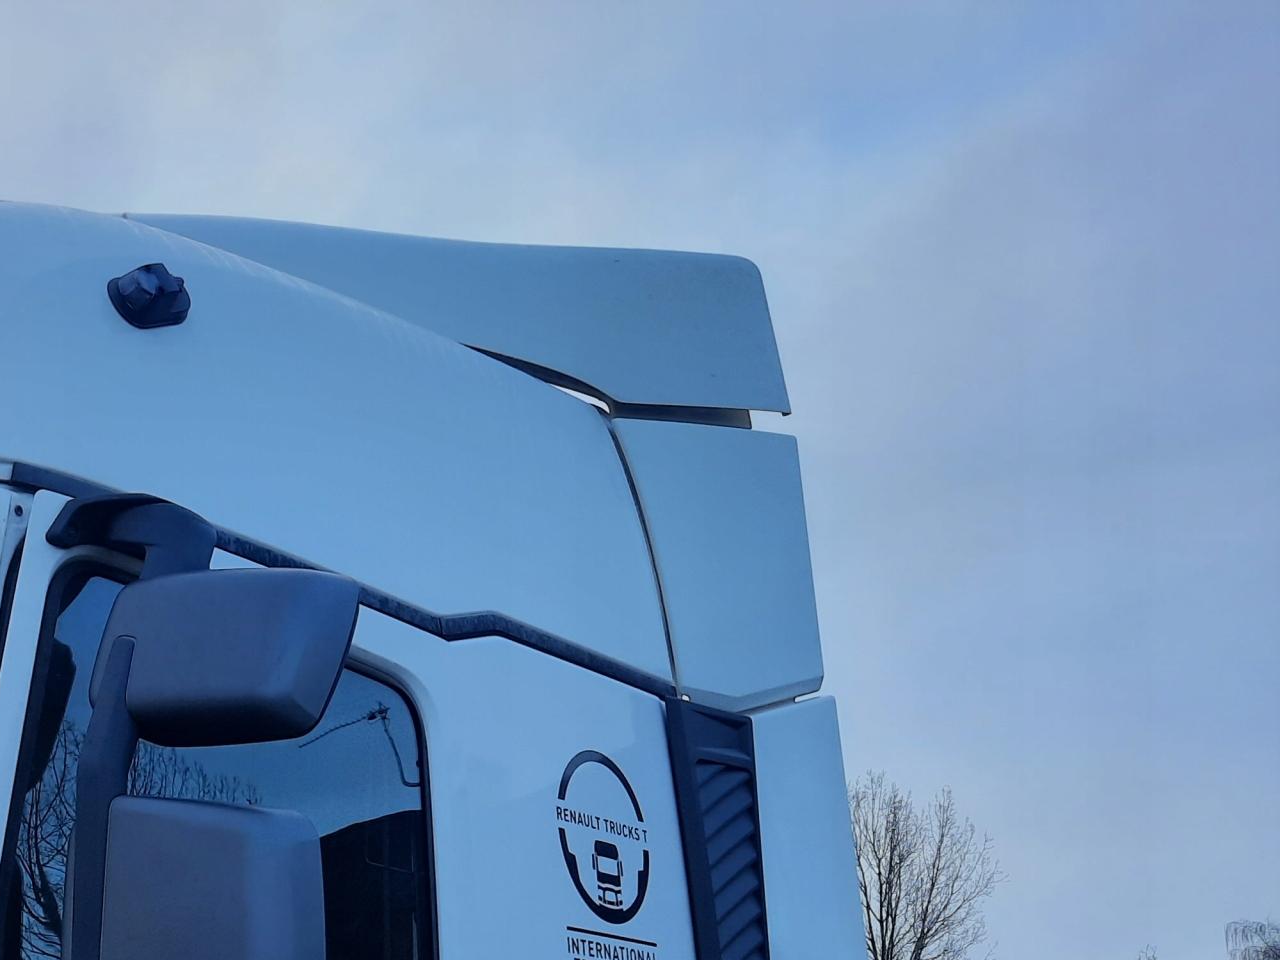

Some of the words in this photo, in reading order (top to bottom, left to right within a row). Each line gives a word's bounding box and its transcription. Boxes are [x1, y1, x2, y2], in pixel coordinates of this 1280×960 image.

[556, 806, 600, 830] RENAULT
[603, 819, 640, 841] TRUCKS
[642, 829, 648, 843] T
